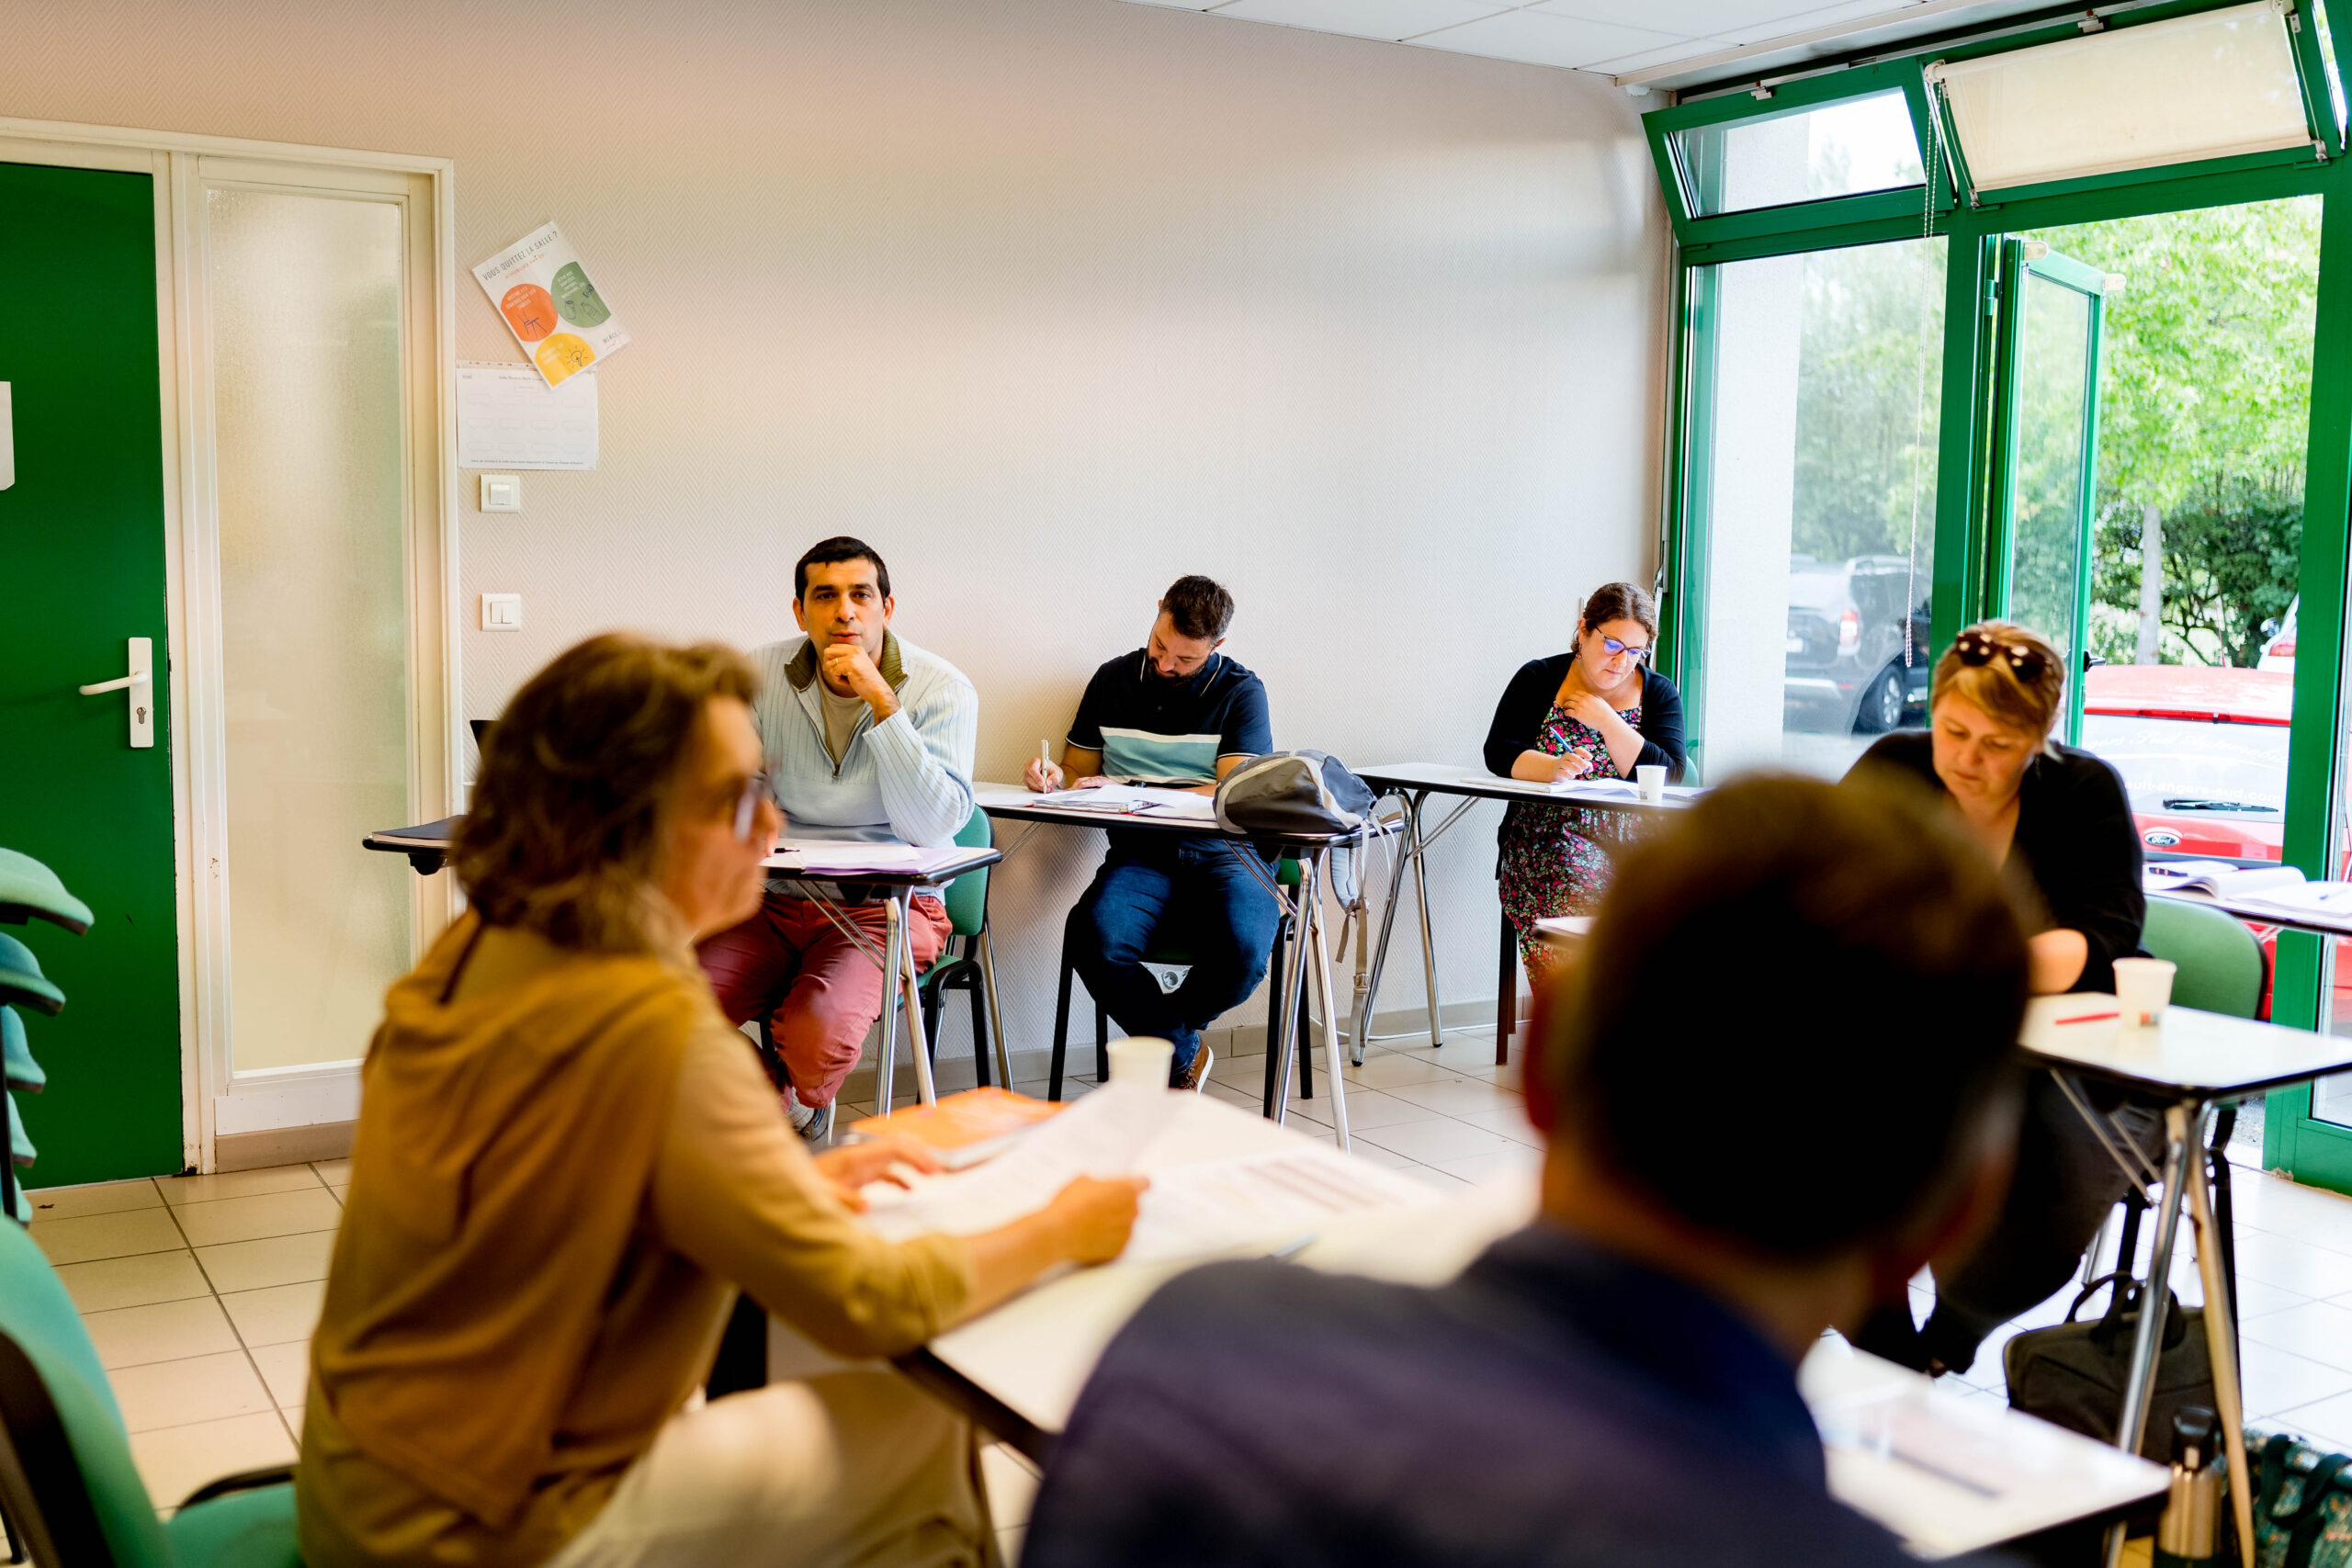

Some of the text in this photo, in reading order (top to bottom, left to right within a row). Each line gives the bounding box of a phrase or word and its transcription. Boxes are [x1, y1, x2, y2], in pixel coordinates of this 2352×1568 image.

[482, 266, 501, 280] VOUS
[500, 251, 526, 270] QUITTEZ
[526, 246, 535, 255] LA
[534, 234, 553, 250] SALLE
